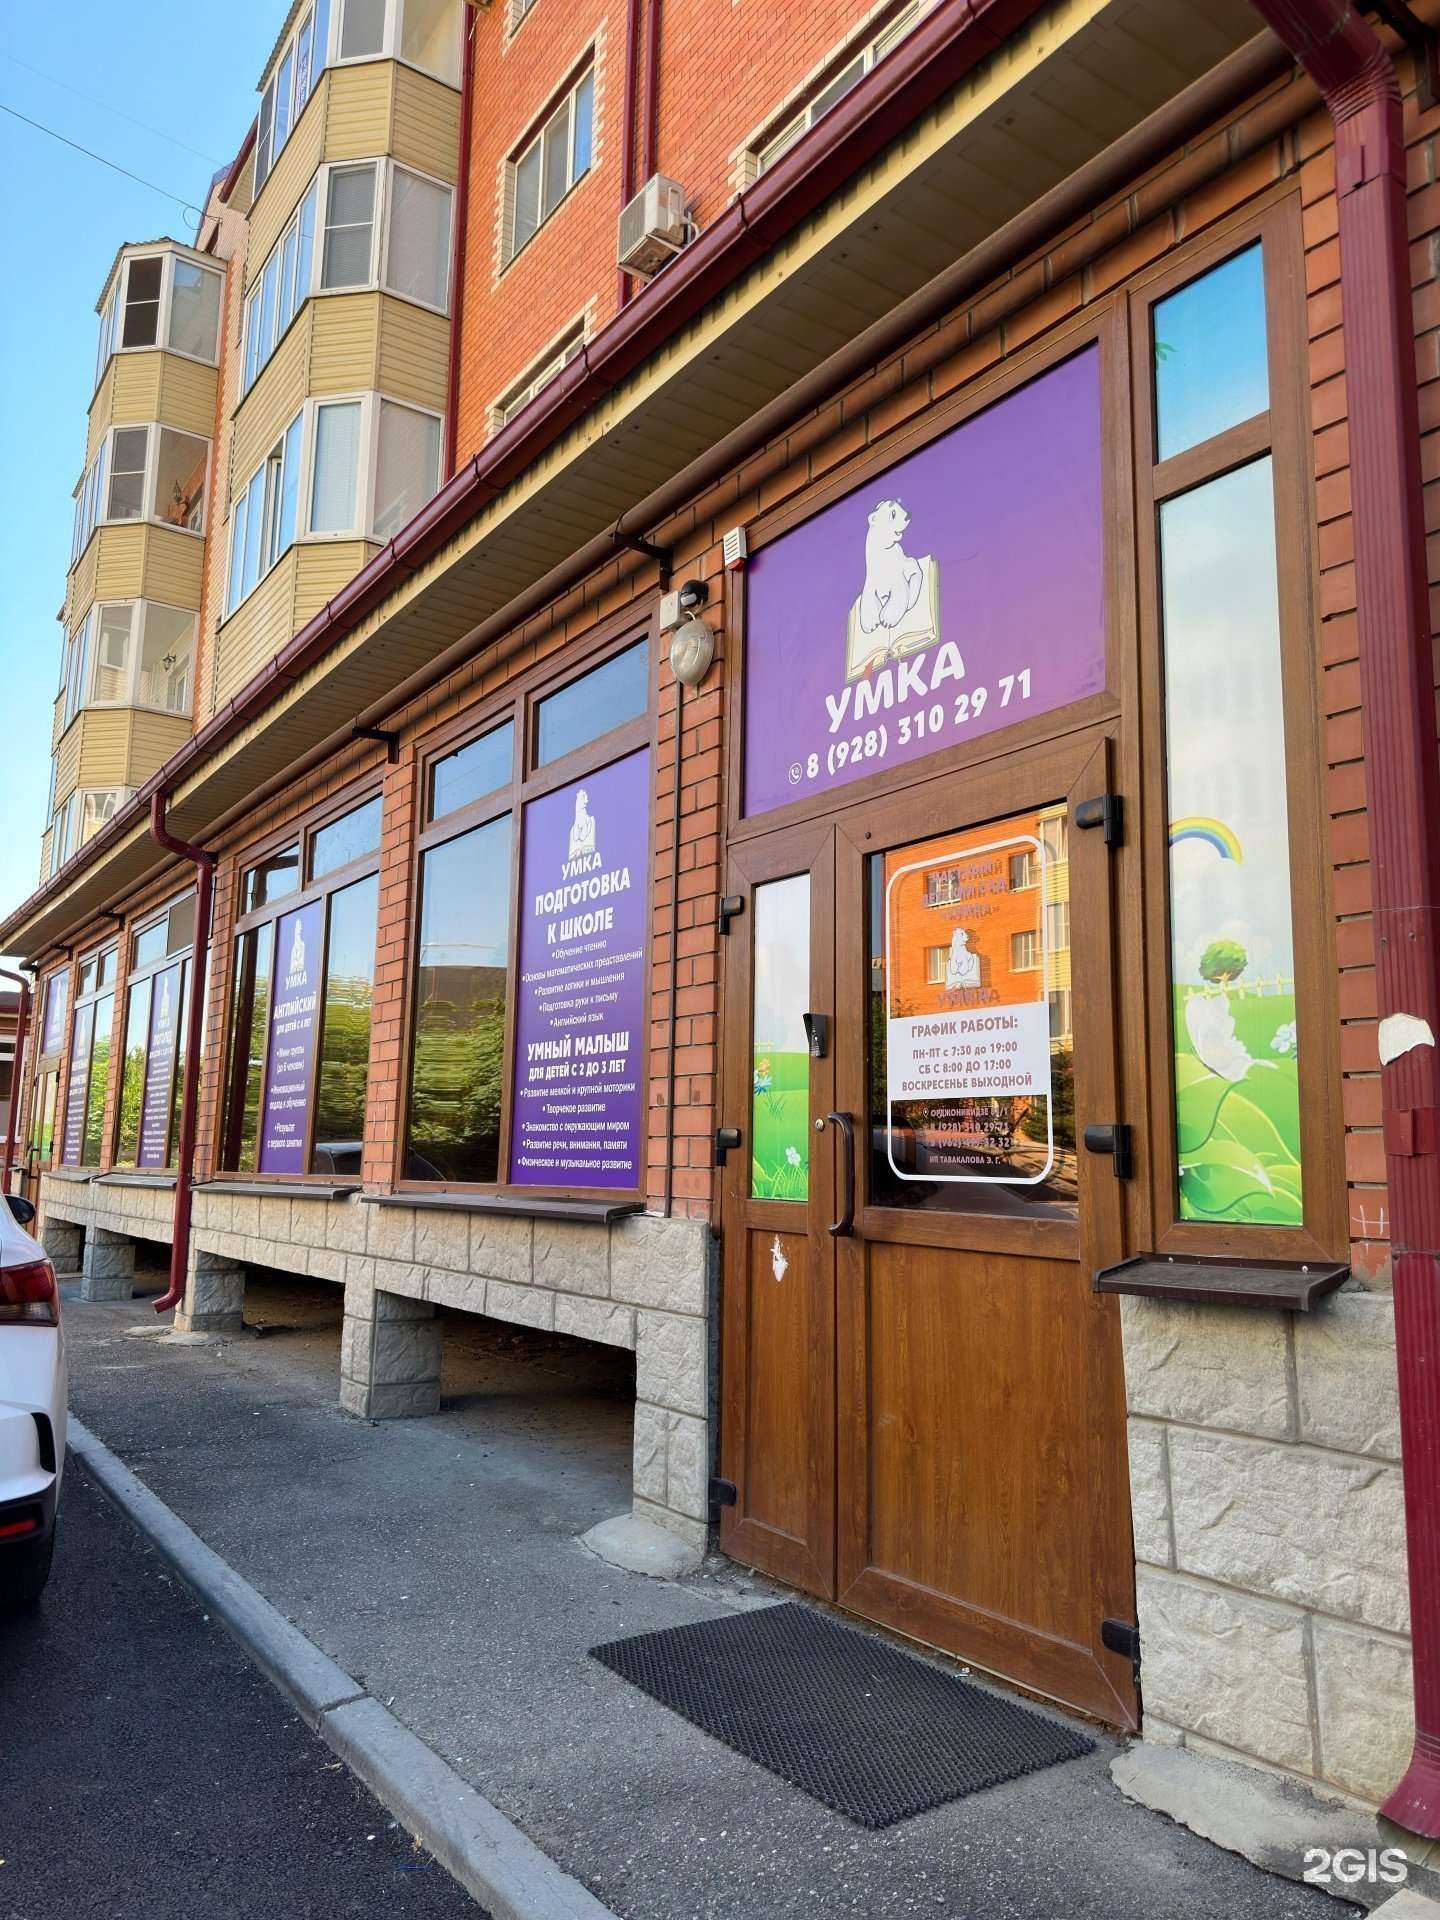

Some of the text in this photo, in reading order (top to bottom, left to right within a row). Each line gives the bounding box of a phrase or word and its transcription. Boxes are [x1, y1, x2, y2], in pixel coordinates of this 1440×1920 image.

[825, 641, 965, 732] УМКА
[806, 669, 1031, 779] 8 (928) 310 29 71
[561, 852, 602, 880] УМКА
[535, 867, 631, 916] ПОДГОТОВКА
[547, 907, 614, 944] К ШКОЛЕ
[555, 940, 607, 959] Обучение чтению
[525, 947, 644, 983] Основы математических представлений
[285, 971, 307, 991] УМКА
[538, 972, 625, 997] Развитие логики и мышления
[274, 991, 317, 1020] АНГЛИЙСКИЙ
[542, 999, 574, 1013] Подготовка
[575, 997, 589, 1009] руки
[594, 991, 619, 1004] письму
[553, 1012, 604, 1027] Английский язык
[911, 1015, 1018, 1038] ГРАФИК РАБОТЫ:
[527, 1031, 630, 1062] УМНЫЙ МАЛЫШ
[912, 1041, 1018, 1060] ПН-ПТ с 7:30 до 19:00
[528, 1058, 626, 1082] ДЛЯ ДЕТЕЙ С 2 ДО 3 ЛЕТ
[918, 1059, 1012, 1075] СБ С 8:00 ДО 17:00
[523, 1082, 636, 1098] Развитие мелкой и крупной моторики
[902, 1071, 1032, 1092] ВОСКРЕСЕНЬЕ ВЫХОДНОЙ
[577, 1103, 606, 1116] развитие
[930, 1107, 989, 1118] ОРДЖОНИКИДЗЕ
[525, 1122, 559, 1132] Знакомство
[564, 1122, 606, 1133] окружающим
[606, 1121, 630, 1133] миром
[984, 1122, 995, 1132] 29
[526, 1139, 552, 1150] Развитие
[603, 1140, 628, 1150] памяти
[521, 1156, 633, 1171] Физическое и музыкальное развитие
[929, 1155, 938, 1164] ИП
[939, 1155, 985, 1165] ТАВАКАЛОВА
